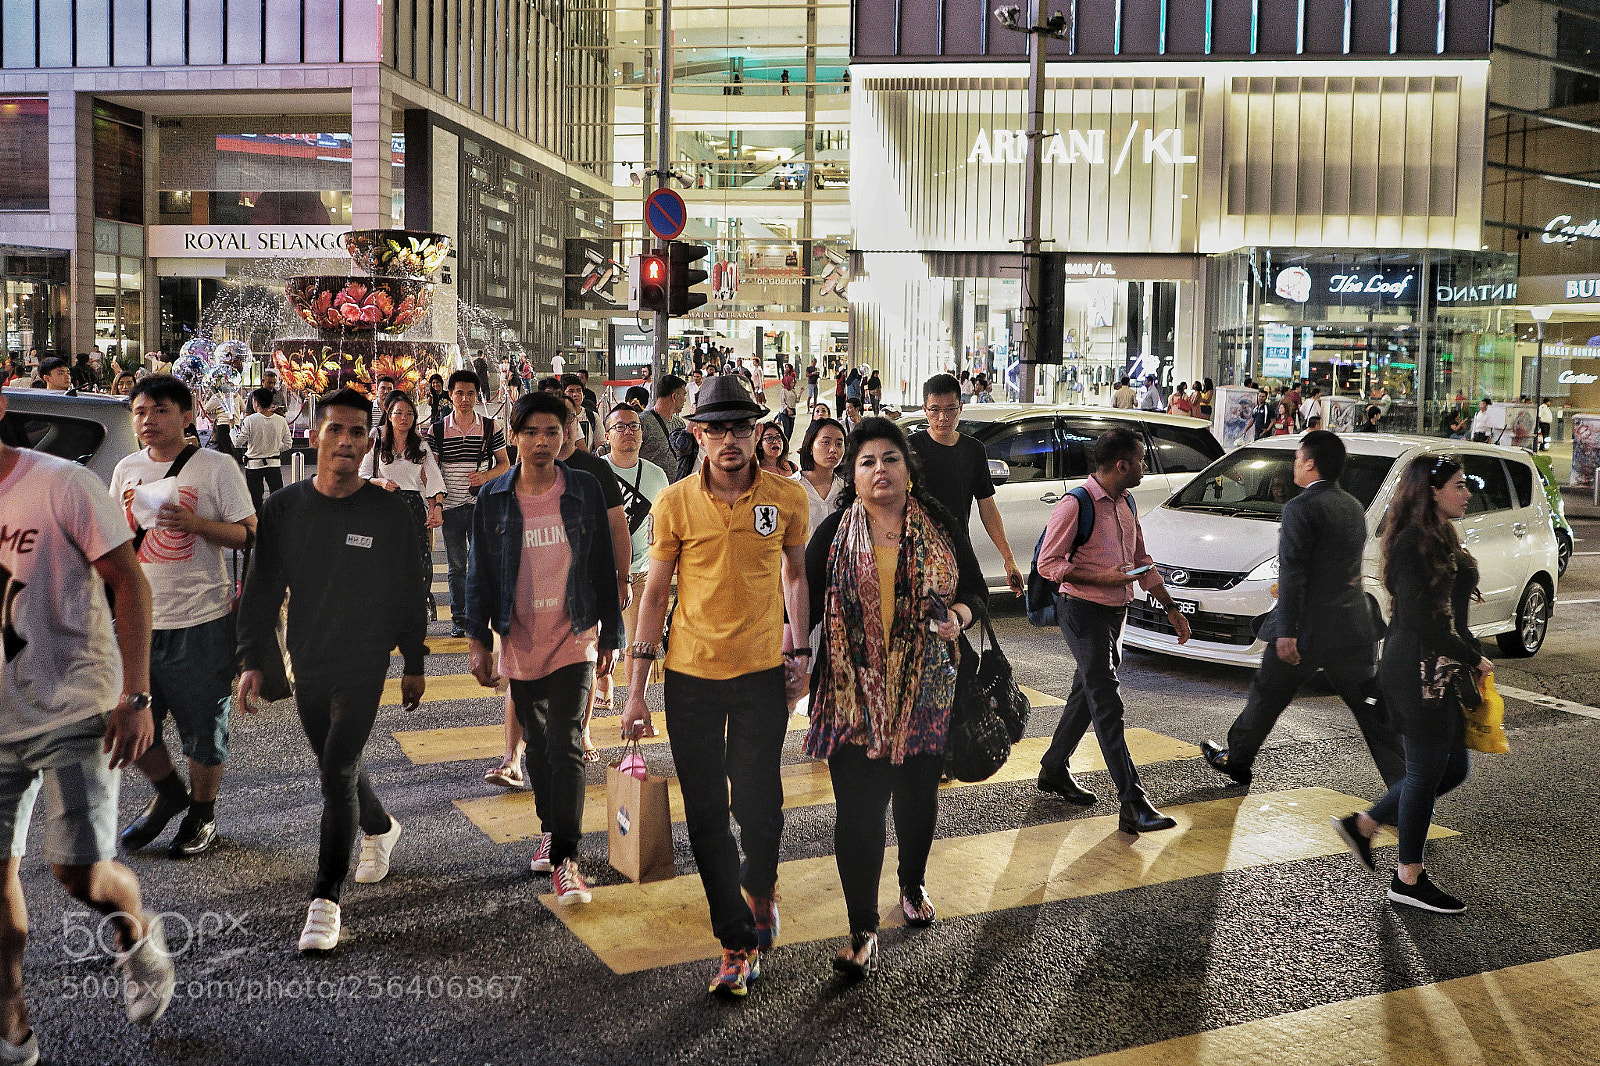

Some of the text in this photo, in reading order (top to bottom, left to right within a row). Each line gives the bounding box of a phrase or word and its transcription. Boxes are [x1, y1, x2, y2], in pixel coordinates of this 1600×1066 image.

[1143, 128, 1197, 164] KL
[184, 233, 346, 250] ROYAL SELANGO
[757, 267, 806, 277] ROUGE G
[1329, 274, 1413, 299] The Loaf
[1565, 279, 1600, 299] BU
[713, 311, 759, 319] ENTRANCE
[522, 526, 568, 548] RILLIN
